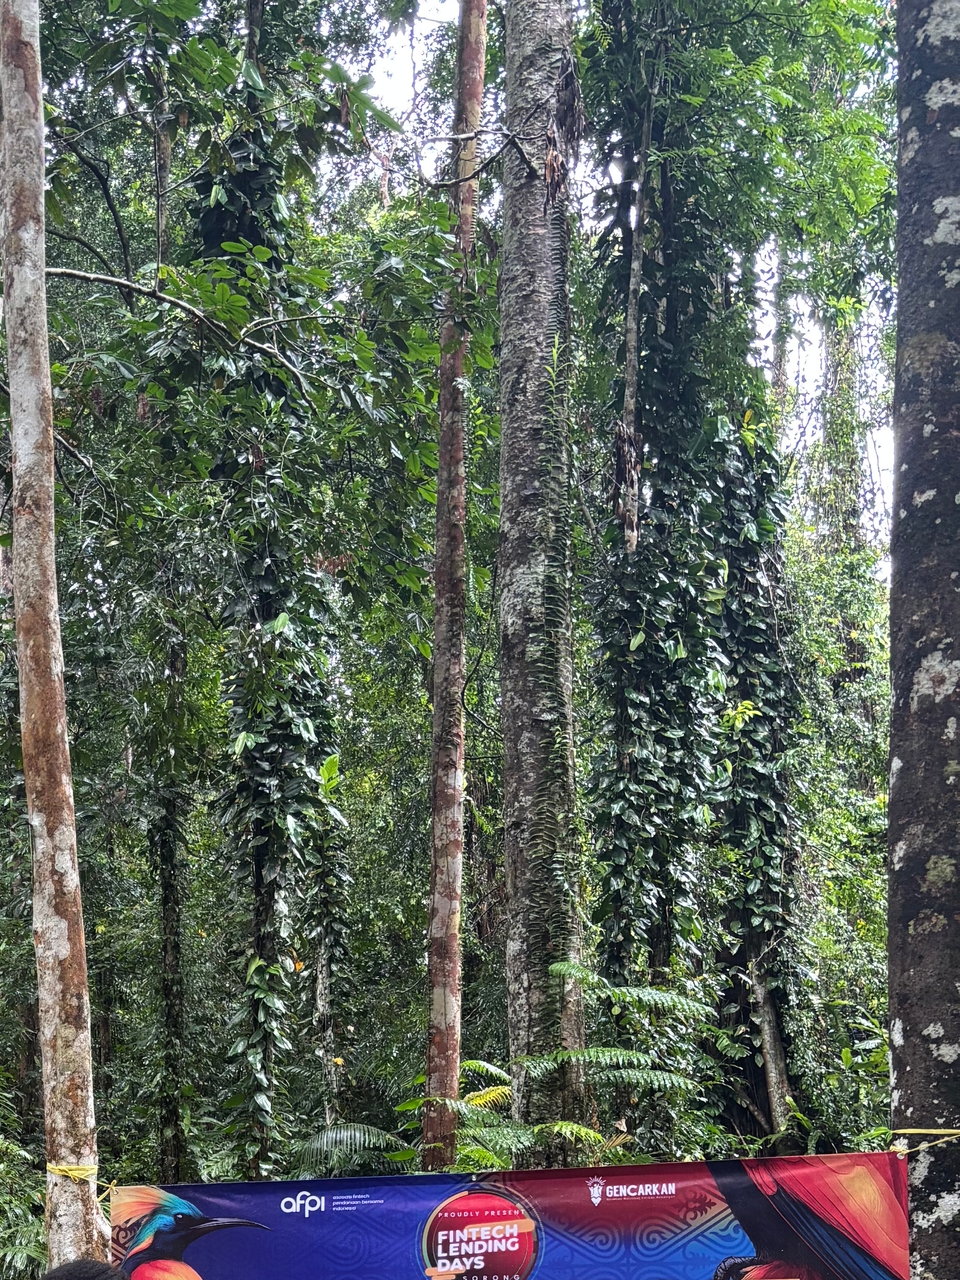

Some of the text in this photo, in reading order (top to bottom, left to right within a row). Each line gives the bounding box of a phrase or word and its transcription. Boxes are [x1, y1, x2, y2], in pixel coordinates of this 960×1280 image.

[606, 1183, 675, 1197] GENCARKAN
[280, 1191, 325, 1218] afpi
[438, 1224, 518, 1243] FINTECH
[438, 1238, 519, 1257] LENDING
[437, 1256, 485, 1272] DAYS
